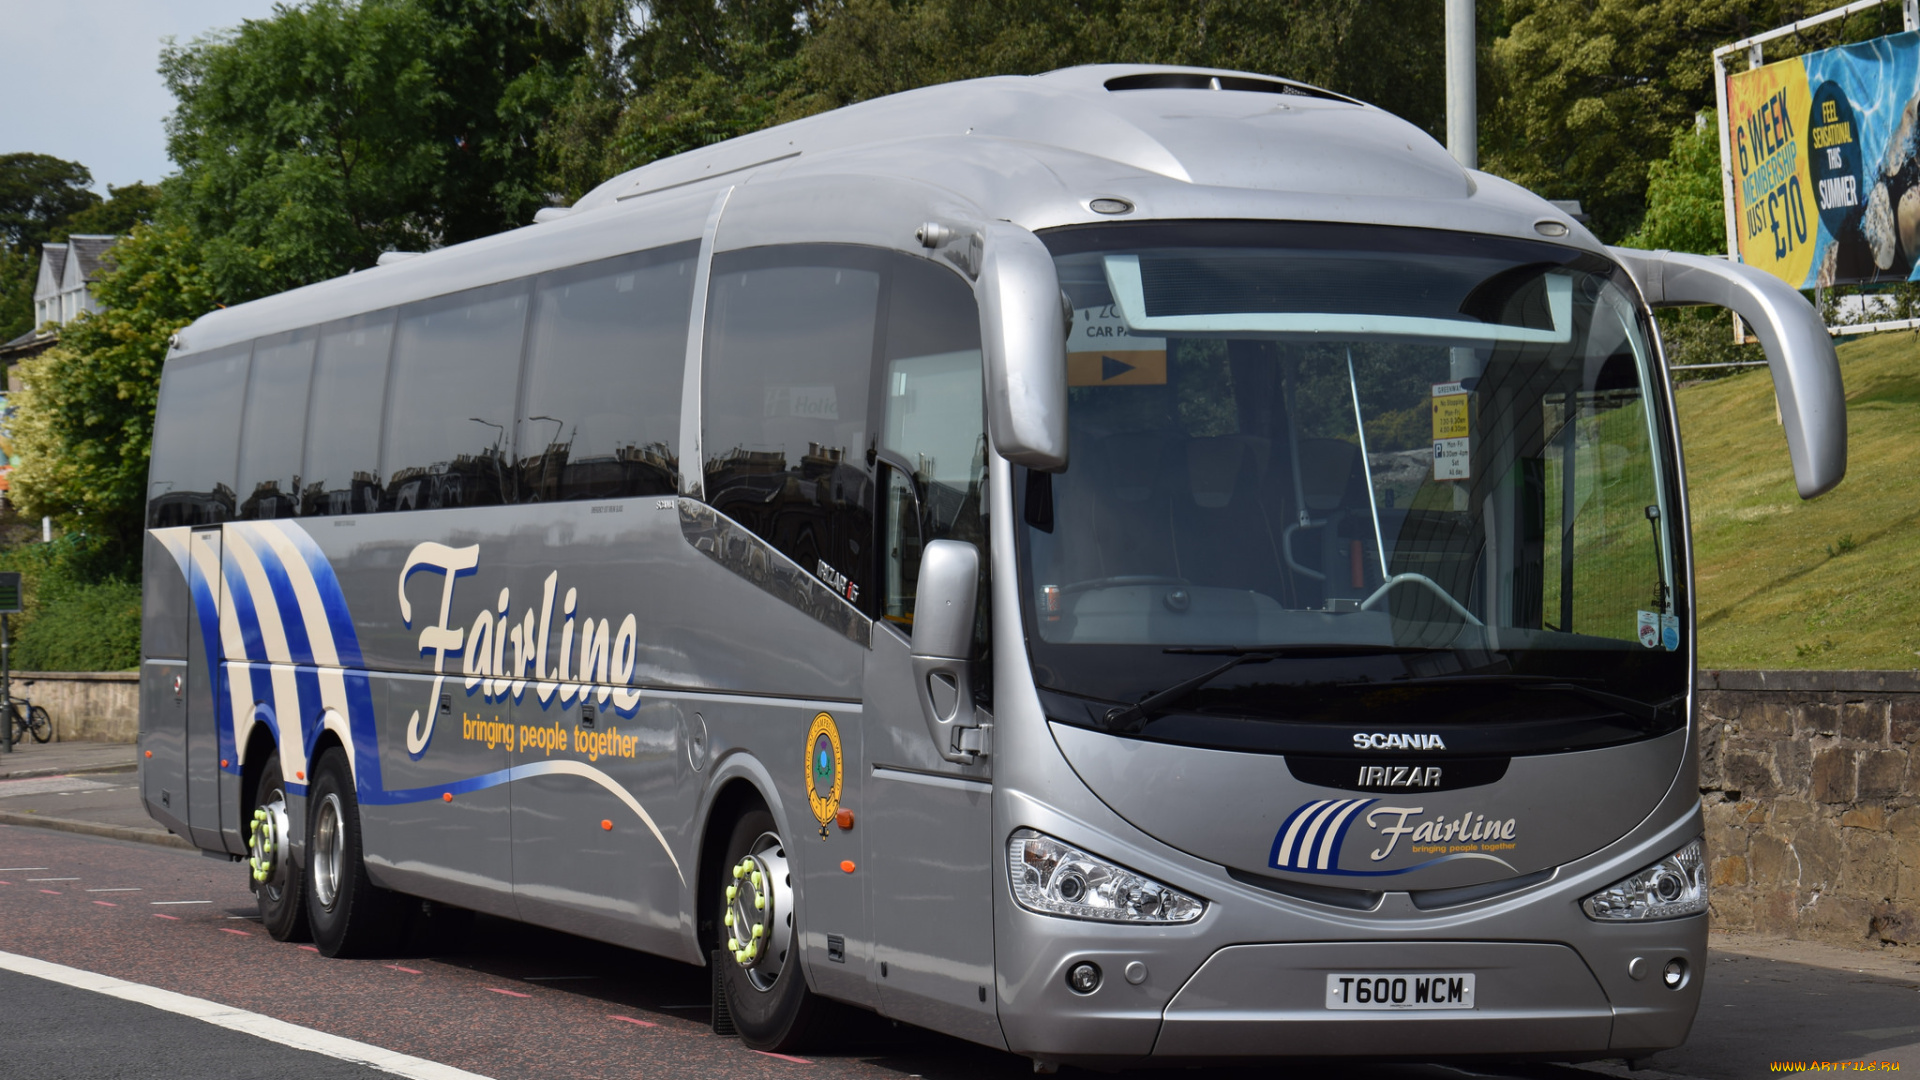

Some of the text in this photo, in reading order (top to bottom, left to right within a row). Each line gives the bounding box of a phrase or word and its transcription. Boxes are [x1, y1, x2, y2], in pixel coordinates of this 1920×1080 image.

[1822, 100, 1838, 123] FEEL
[1737, 86, 1794, 177] 6 WEEK
[1812, 121, 1853, 149] SENSATIONAL
[1826, 147, 1842, 170] THIS
[1742, 140, 1797, 209] MEMBERSHIP
[1819, 175, 1858, 210] SUMMER
[1746, 174, 1807, 262] JUST £70
[1086, 326, 1113, 338] CAR
[816, 559, 848, 596] IRIZAR
[398, 541, 642, 758] Fairline
[463, 712, 639, 762] bringing people together
[1353, 733, 1446, 750] SCANIA
[1358, 766, 1443, 787] IRIZAR
[1366, 806, 1516, 861] Fairline
[1412, 842, 1516, 854] bringing people together
[1339, 977, 1463, 1003] T600 WCM
